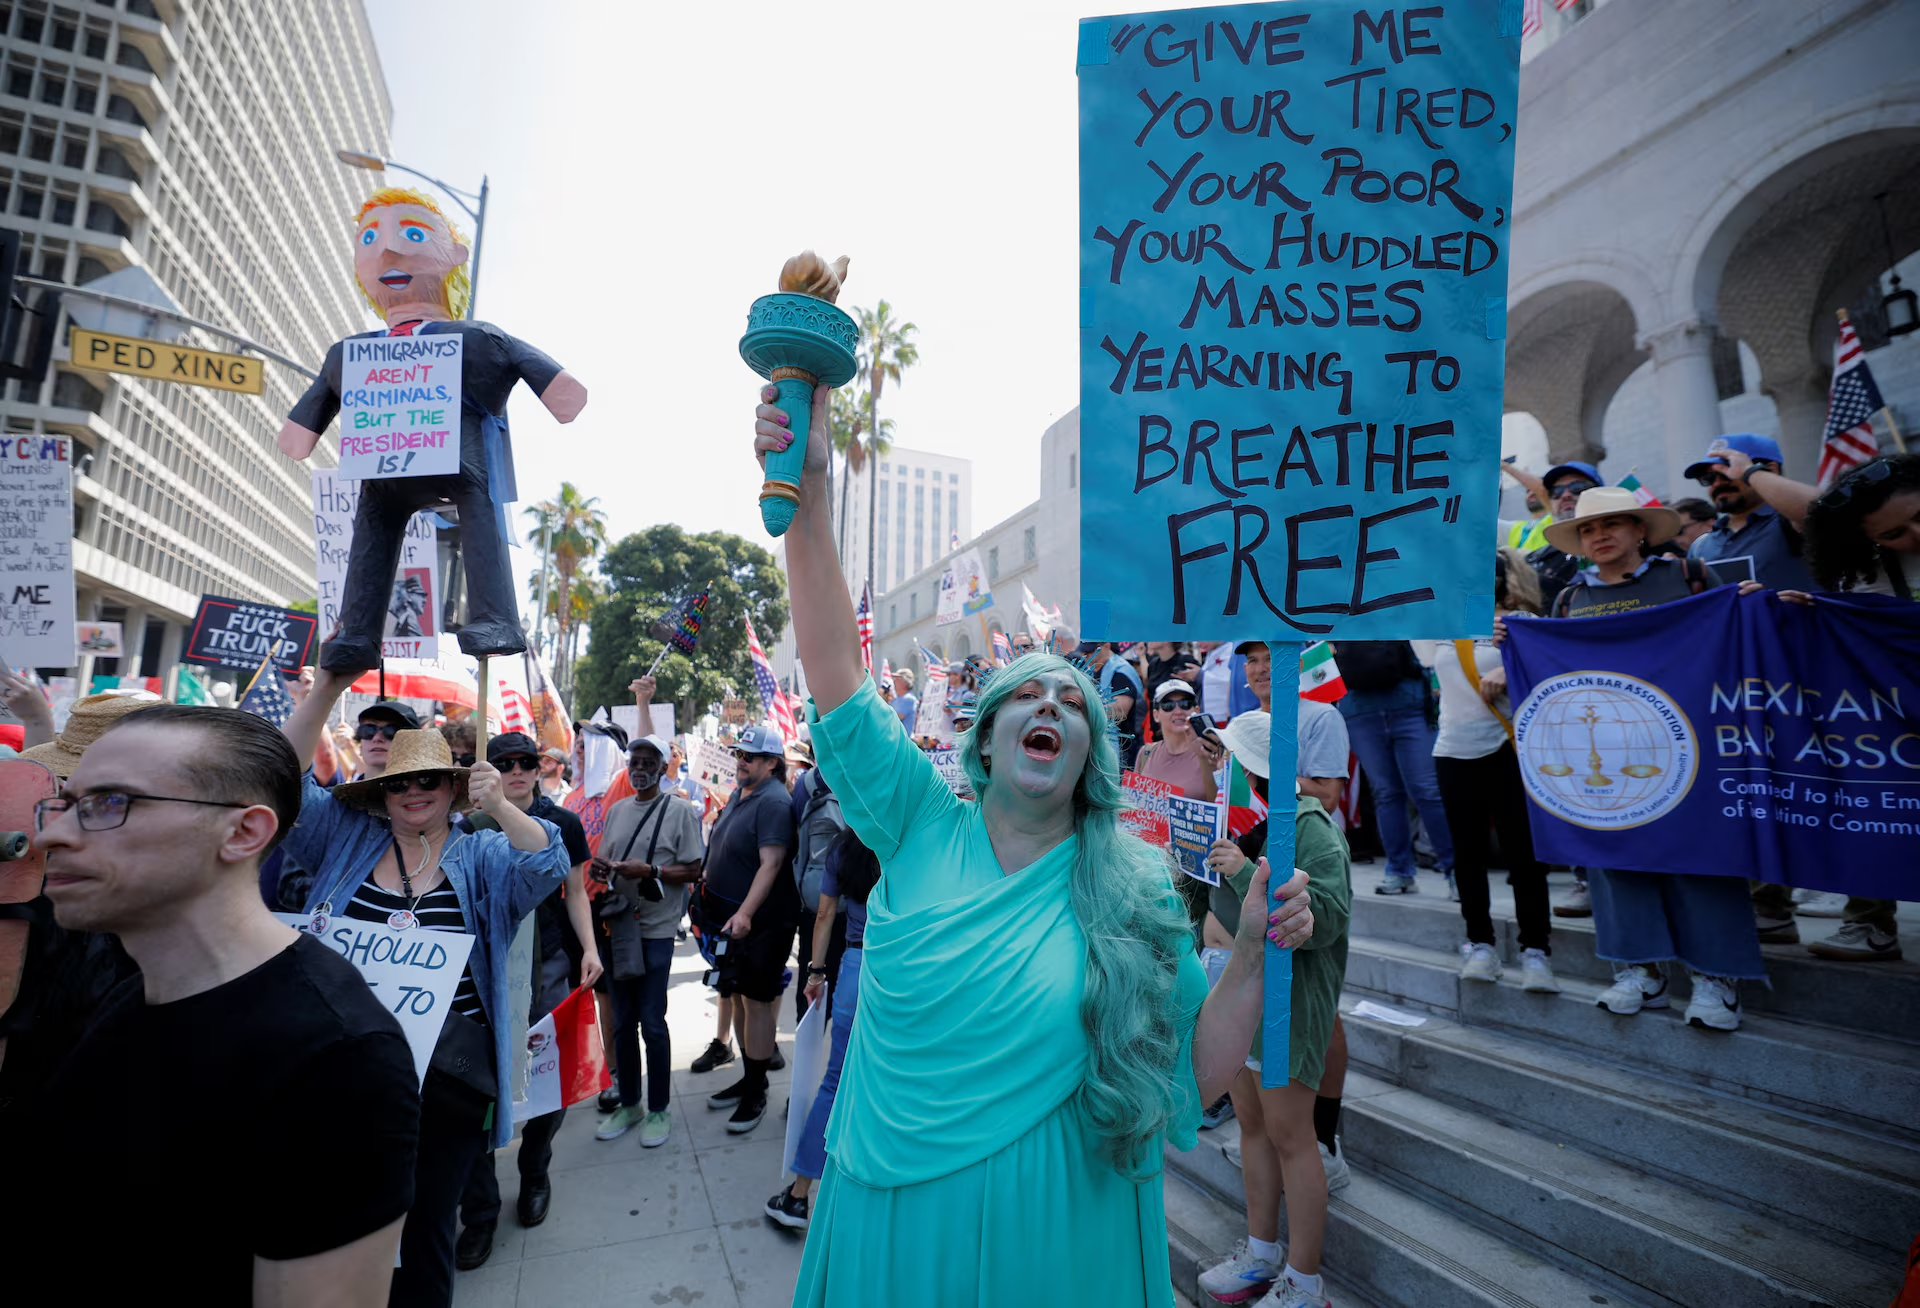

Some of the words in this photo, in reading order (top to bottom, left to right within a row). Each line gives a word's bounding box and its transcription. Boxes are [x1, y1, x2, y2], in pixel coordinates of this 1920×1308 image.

[1351, 6, 1444, 65] ME
[1134, 88, 1315, 147] YOUR
[1324, 67, 1512, 149] TIRED,
[1147, 151, 1312, 213] YOUR
[1321, 147, 1505, 228] POOR,
[1093, 219, 1256, 284] YOUR
[1264, 212, 1499, 276] HUDDLED
[1179, 275, 1425, 331] MASSES
[90, 338, 156, 369] PED
[172, 350, 247, 385] XING
[349, 340, 460, 362] IMMIGRANTS
[364, 364, 433, 385] AREN'T
[1100, 331, 1353, 415] YEARNING
[1385, 350, 1461, 395] TO
[343, 385, 453, 408] CRIMINALS,
[354, 411, 396, 429] BUT
[407, 409, 445, 425] THE
[17, 437, 68, 461] CAME
[340, 430, 450, 457] PRESIDENT
[1133, 415, 1455, 498] BREATHE
[377, 451, 416, 474] IS!
[1168, 495, 1462, 633] FREE"
[11, 585, 51, 605] ME
[226, 612, 291, 639] FUCK
[208, 628, 299, 658] TRUMP
[381, 641, 421, 658] ESIST!
[1517, 703, 1538, 742] MEXICAN
[1536, 677, 1594, 703] AMERICAN
[1596, 677, 1622, 690] BAR
[1624, 684, 1687, 742] ASSOCIATION
[1666, 752, 1689, 795] Community
[1722, 799, 1744, 817] of
[1805, 788, 1827, 804] to
[1834, 788, 1870, 808] the
[1187, 821, 1194, 831] IN
[1201, 835, 1208, 845] IN
[332, 928, 447, 970] SHOULD
[392, 985, 435, 1016] TO
